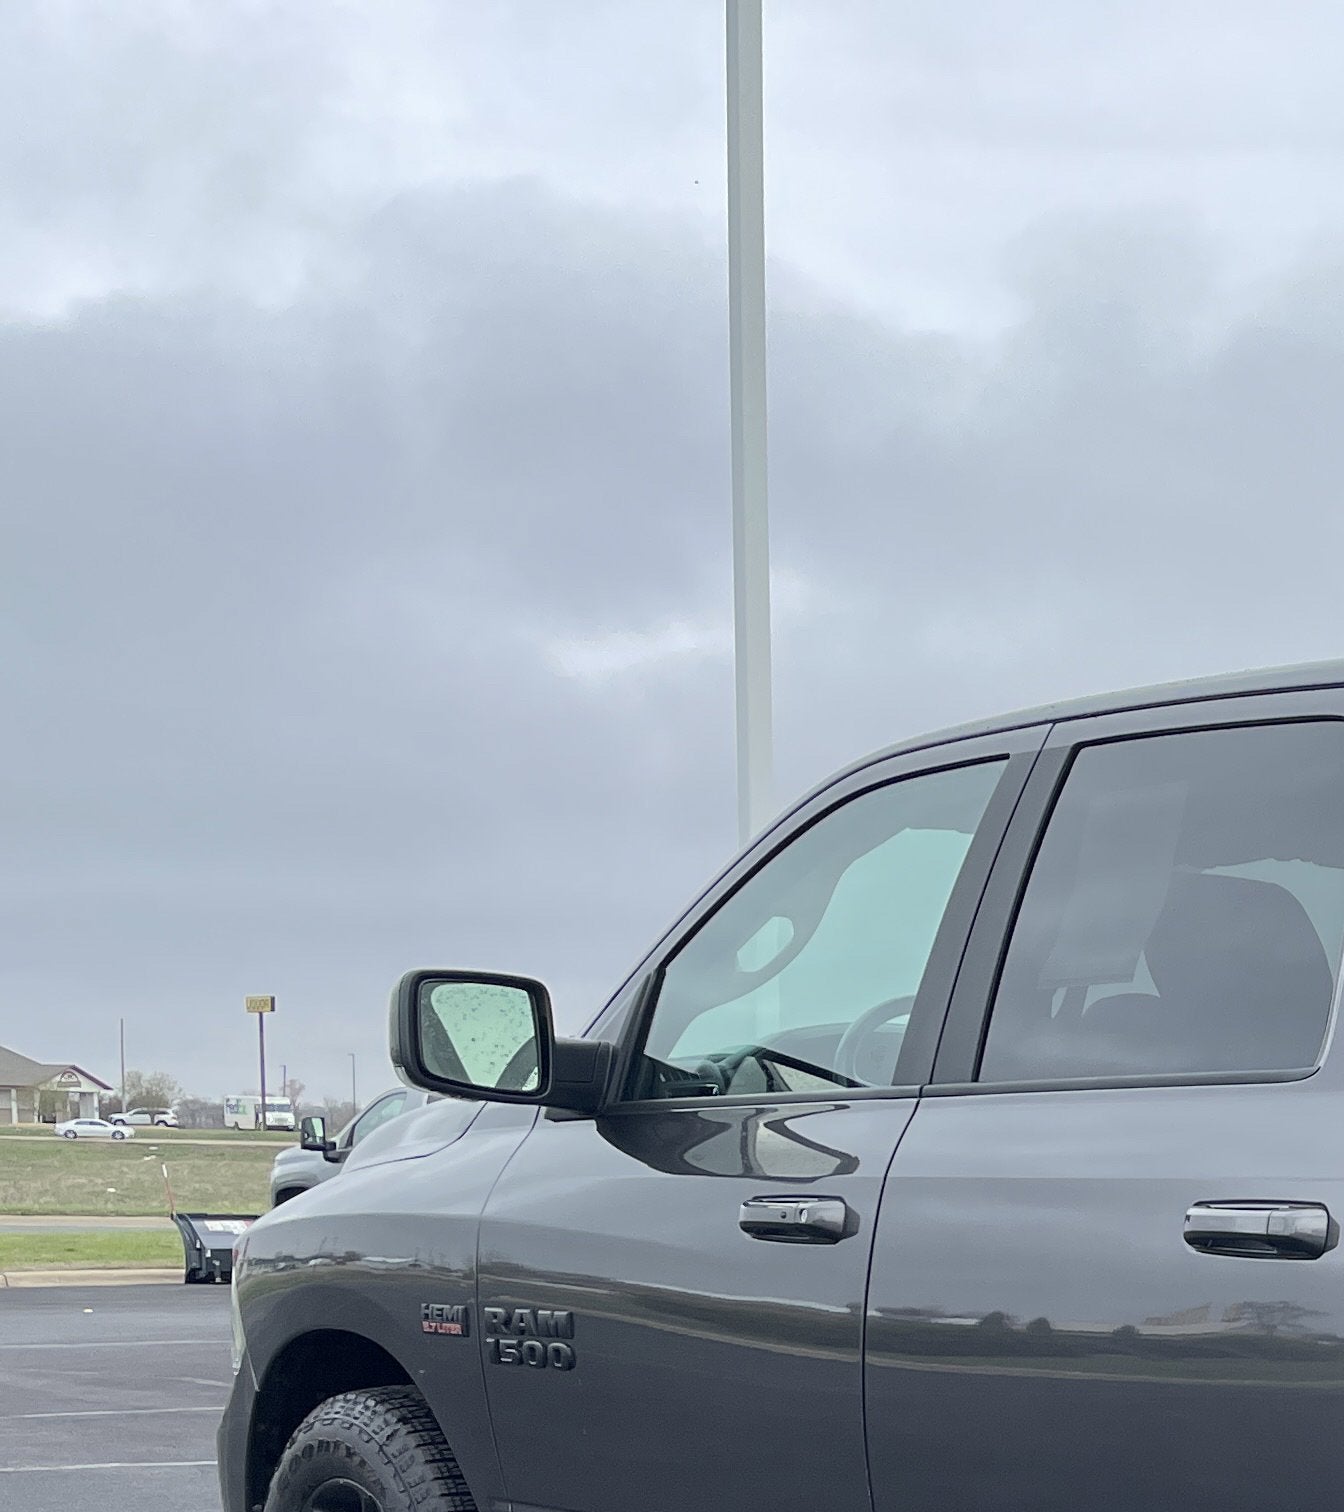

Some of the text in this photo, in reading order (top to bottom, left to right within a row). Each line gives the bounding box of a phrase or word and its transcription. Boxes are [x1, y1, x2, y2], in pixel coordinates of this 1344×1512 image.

[421, 1303, 466, 1321] HEMI
[484, 1306, 574, 1339] RAM
[486, 1338, 576, 1371] 1500
